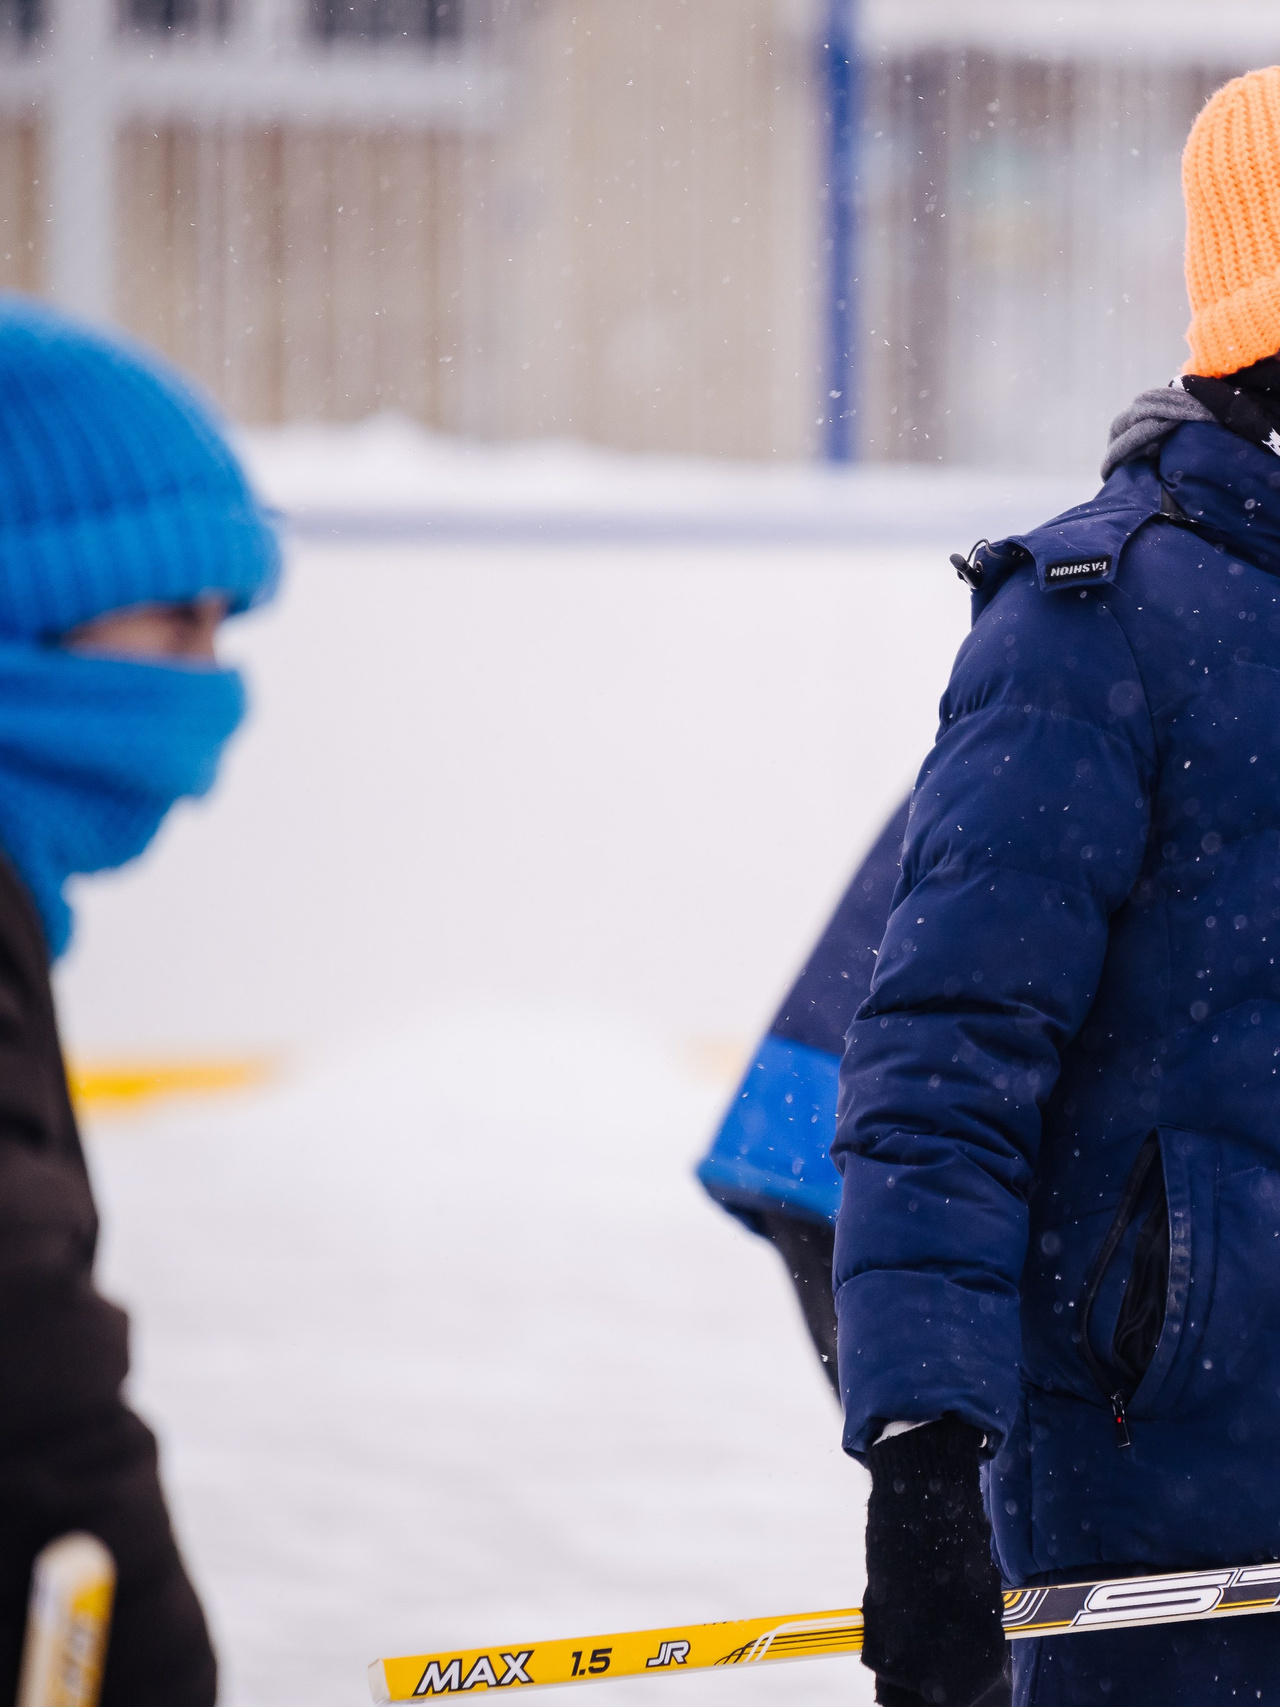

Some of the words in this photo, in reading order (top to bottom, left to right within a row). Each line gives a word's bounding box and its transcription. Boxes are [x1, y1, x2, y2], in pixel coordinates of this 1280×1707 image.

[1050, 561, 1107, 577] FASHION
[413, 1650, 534, 1696] MAX
[570, 1648, 613, 1677] 1.5
[645, 1640, 691, 1668] JR
